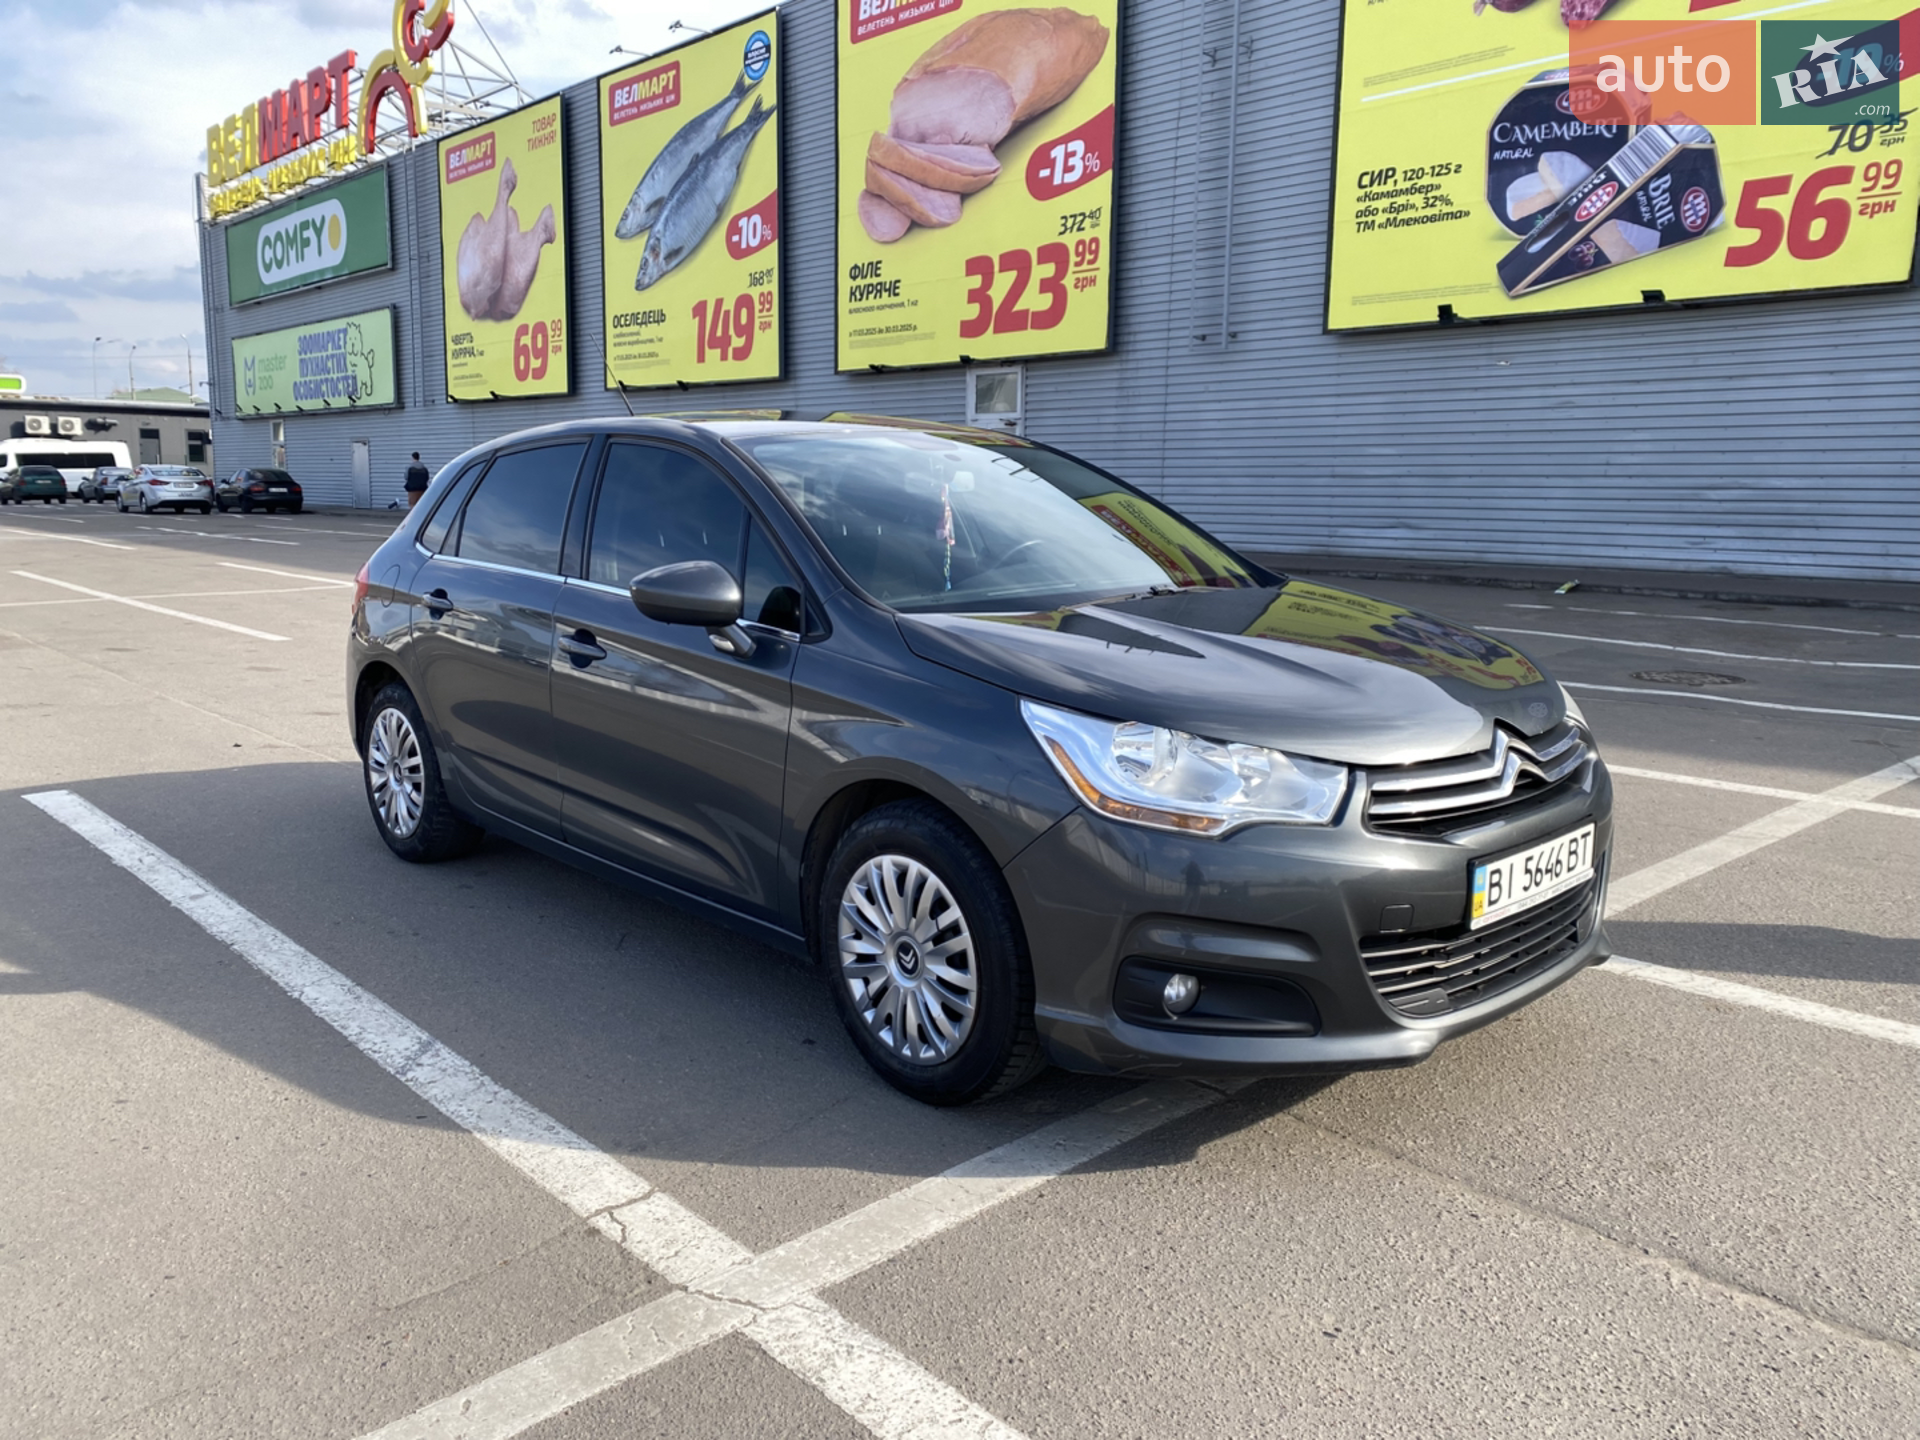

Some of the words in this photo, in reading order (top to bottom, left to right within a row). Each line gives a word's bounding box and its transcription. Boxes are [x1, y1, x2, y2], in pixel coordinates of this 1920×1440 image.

[613, 70, 676, 109] ВЕЛМАРТ
[207, 49, 355, 187] ВЕЛМАРТ
[532, 113, 557, 134] ТОВАР
[1493, 117, 1622, 144] CAMEMBERT
[527, 129, 557, 152] ТИЖНЯ!
[1827, 119, 1875, 156] 70
[1879, 113, 1909, 134] 35
[1880, 136, 1905, 148] грн
[449, 139, 493, 170] ВЕЛМАРТ
[1039, 140, 1100, 186] -13%
[1493, 147, 1534, 160] NATURAL
[1357, 166, 1398, 189] СИР,
[1402, 162, 1452, 182] 120-125
[1453, 163, 1462, 174] г
[1356, 182, 1442, 203] «Камамбер»
[1648, 173, 1676, 230] BRIE
[1355, 205, 1379, 219] або
[1381, 199, 1419, 215] «Брі»,
[1421, 194, 1454, 210] 32%,
[1724, 165, 1856, 267] 56
[1861, 159, 1903, 193] 99
[1858, 200, 1896, 218] грн
[731, 213, 773, 249] -10%
[1058, 212, 1087, 236] 372
[1355, 219, 1376, 233] ТМ
[1377, 209, 1471, 230] «Млековіта»
[262, 214, 326, 274] COMFY
[849, 260, 882, 281] ФІЛЕ
[1073, 274, 1097, 292] грн
[849, 279, 901, 303] КУРЯЧЕ
[959, 241, 1070, 339] 323
[1074, 236, 1100, 267] 99
[613, 309, 666, 329] ОСЕЛЕДЕЦЬ
[692, 293, 755, 364] 149
[758, 291, 773, 314] 99
[298, 328, 347, 356] ЗООМАРКЕТ
[514, 321, 548, 382] 69
[550, 318, 562, 339] 99
[258, 354, 287, 373] master
[299, 352, 348, 378] ПУХНАСТИХ
[258, 375, 273, 390] zoo
[1487, 862, 1514, 908] BI
[1522, 842, 1564, 892] 5646
[1566, 830, 1592, 873] BT
